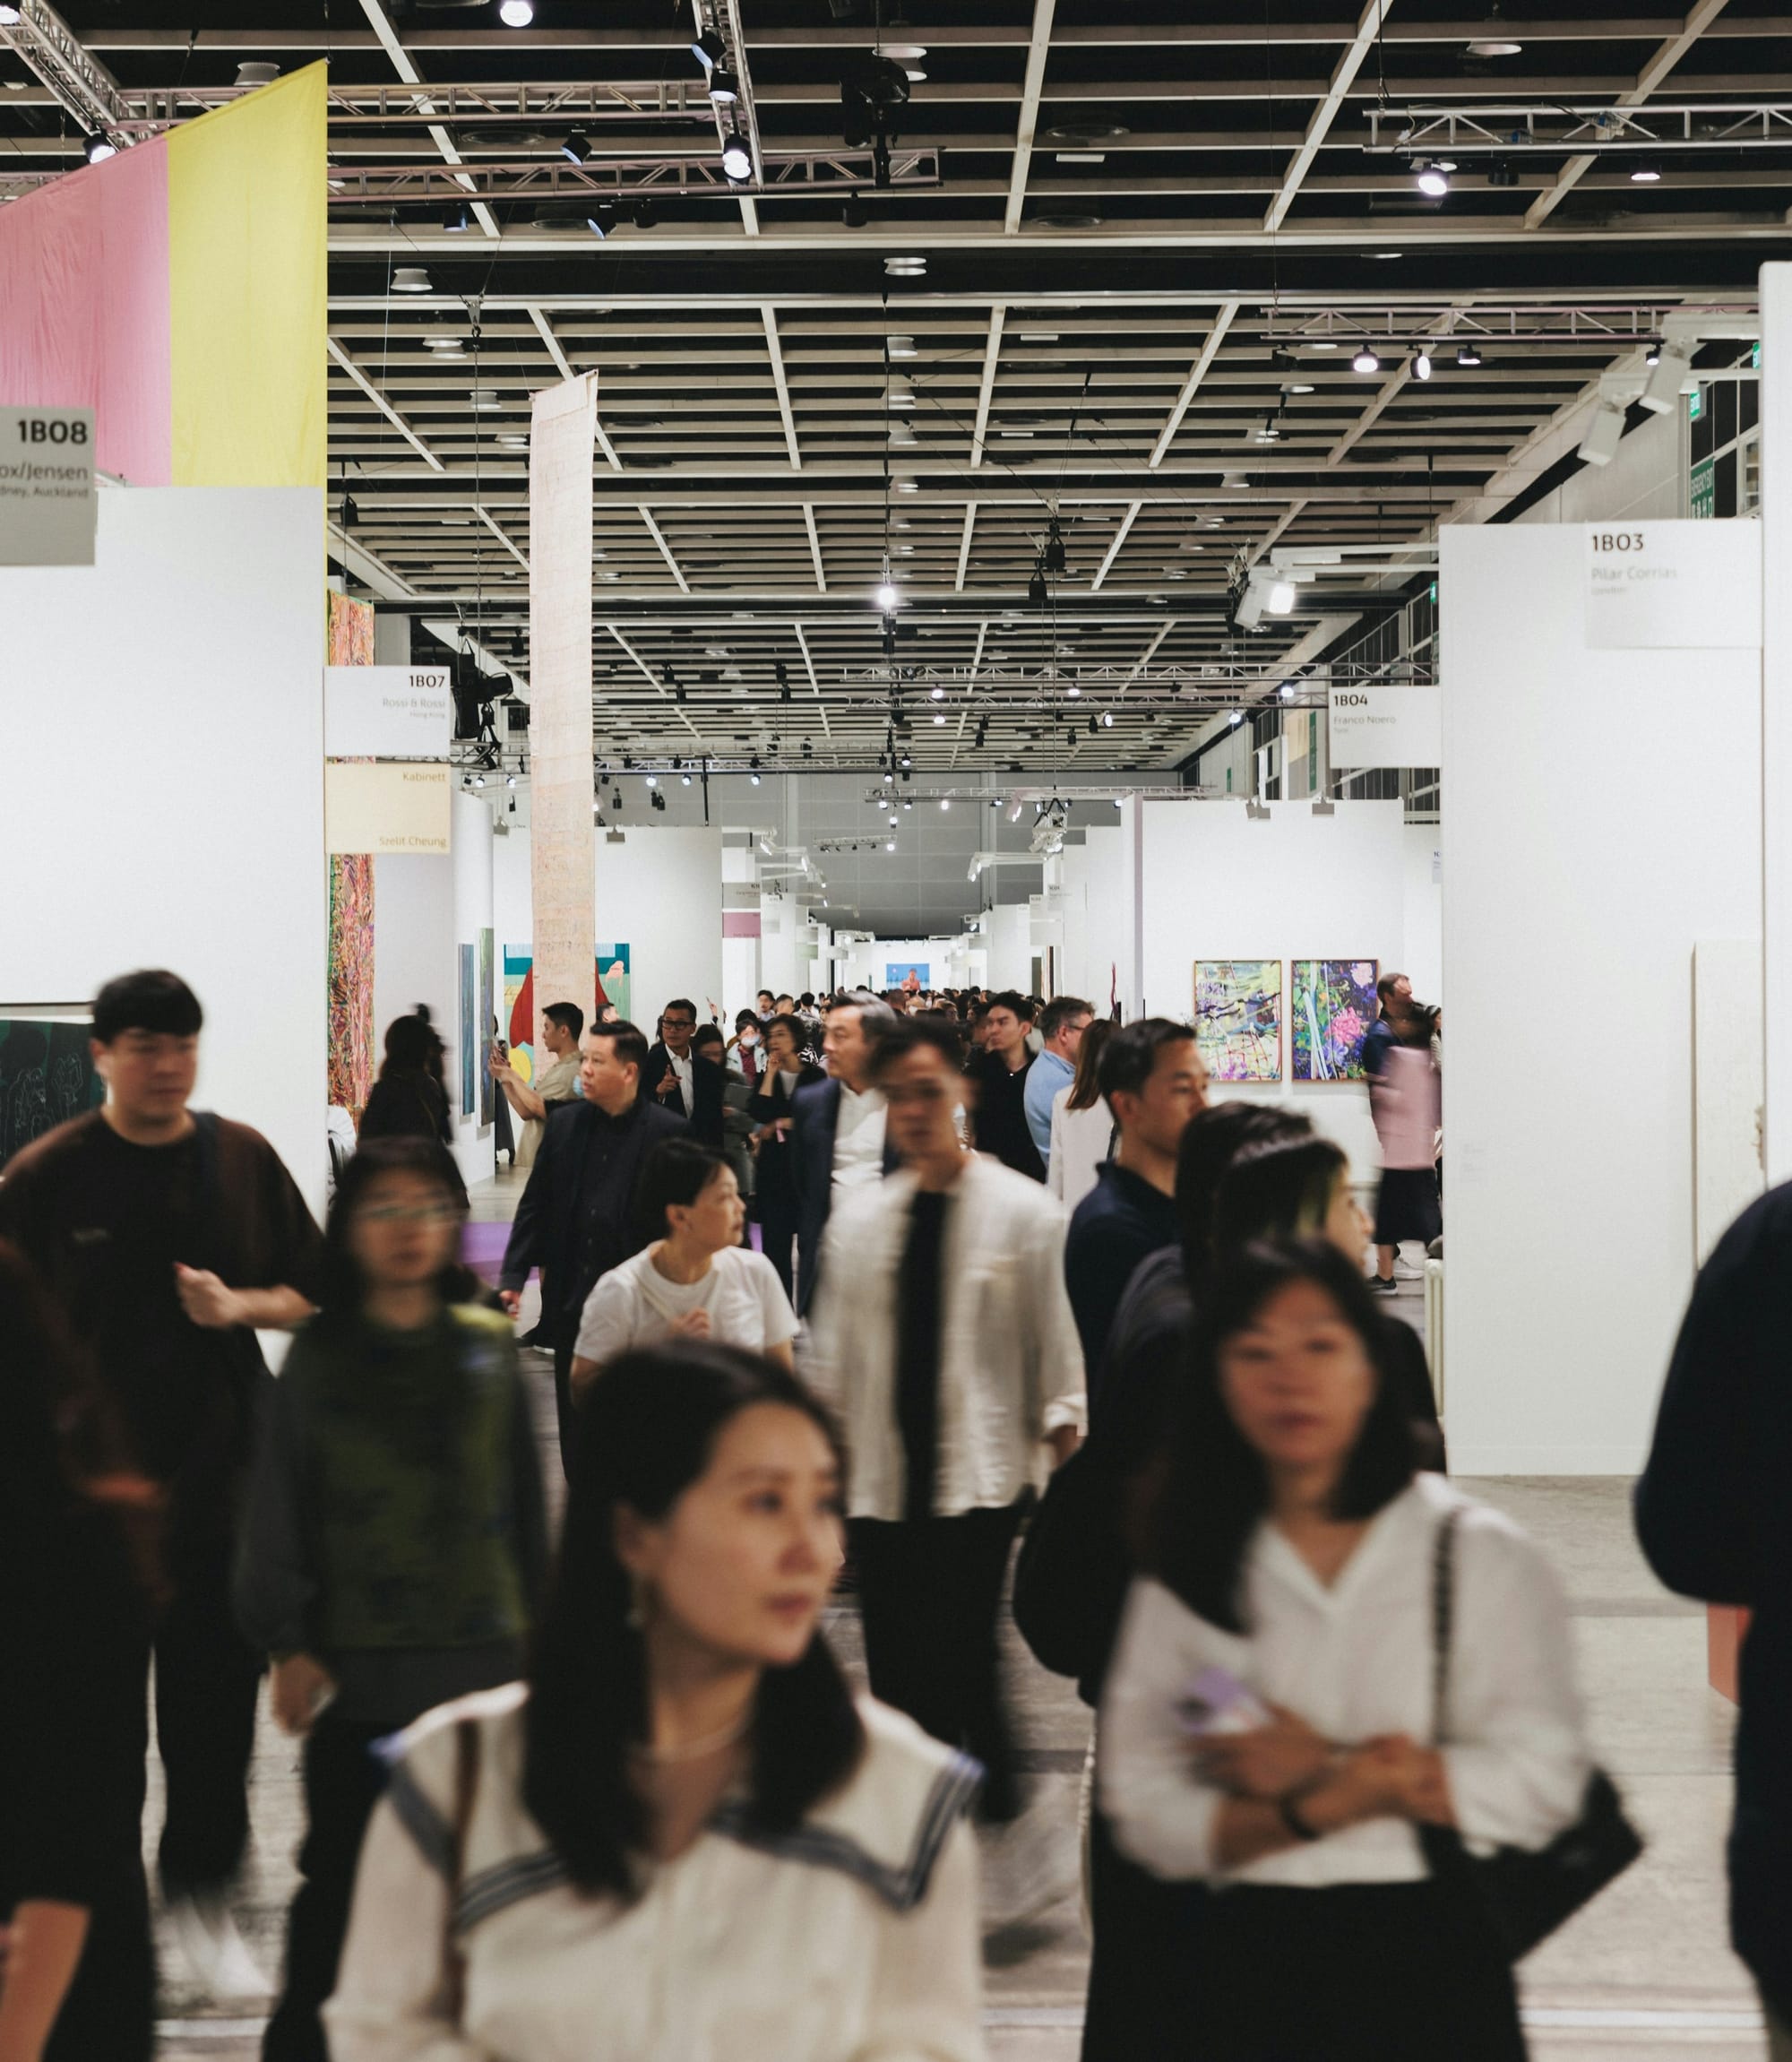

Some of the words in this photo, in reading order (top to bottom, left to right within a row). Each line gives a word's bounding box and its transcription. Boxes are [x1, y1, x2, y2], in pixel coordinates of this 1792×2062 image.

[18, 420, 88, 444] 1B08
[34, 487, 89, 497] Auckland
[1592, 533, 1644, 551] 1B03
[1591, 567, 1623, 580] Pilar
[409, 675, 445, 687] 1B07
[383, 698, 409, 708] Rossi
[420, 698, 445, 708] Rossi
[1334, 695, 1368, 706] 1B04
[1333, 716, 1365, 725] Franco
[402, 772, 446, 782] Kabinett
[409, 837, 447, 848] Cheung
